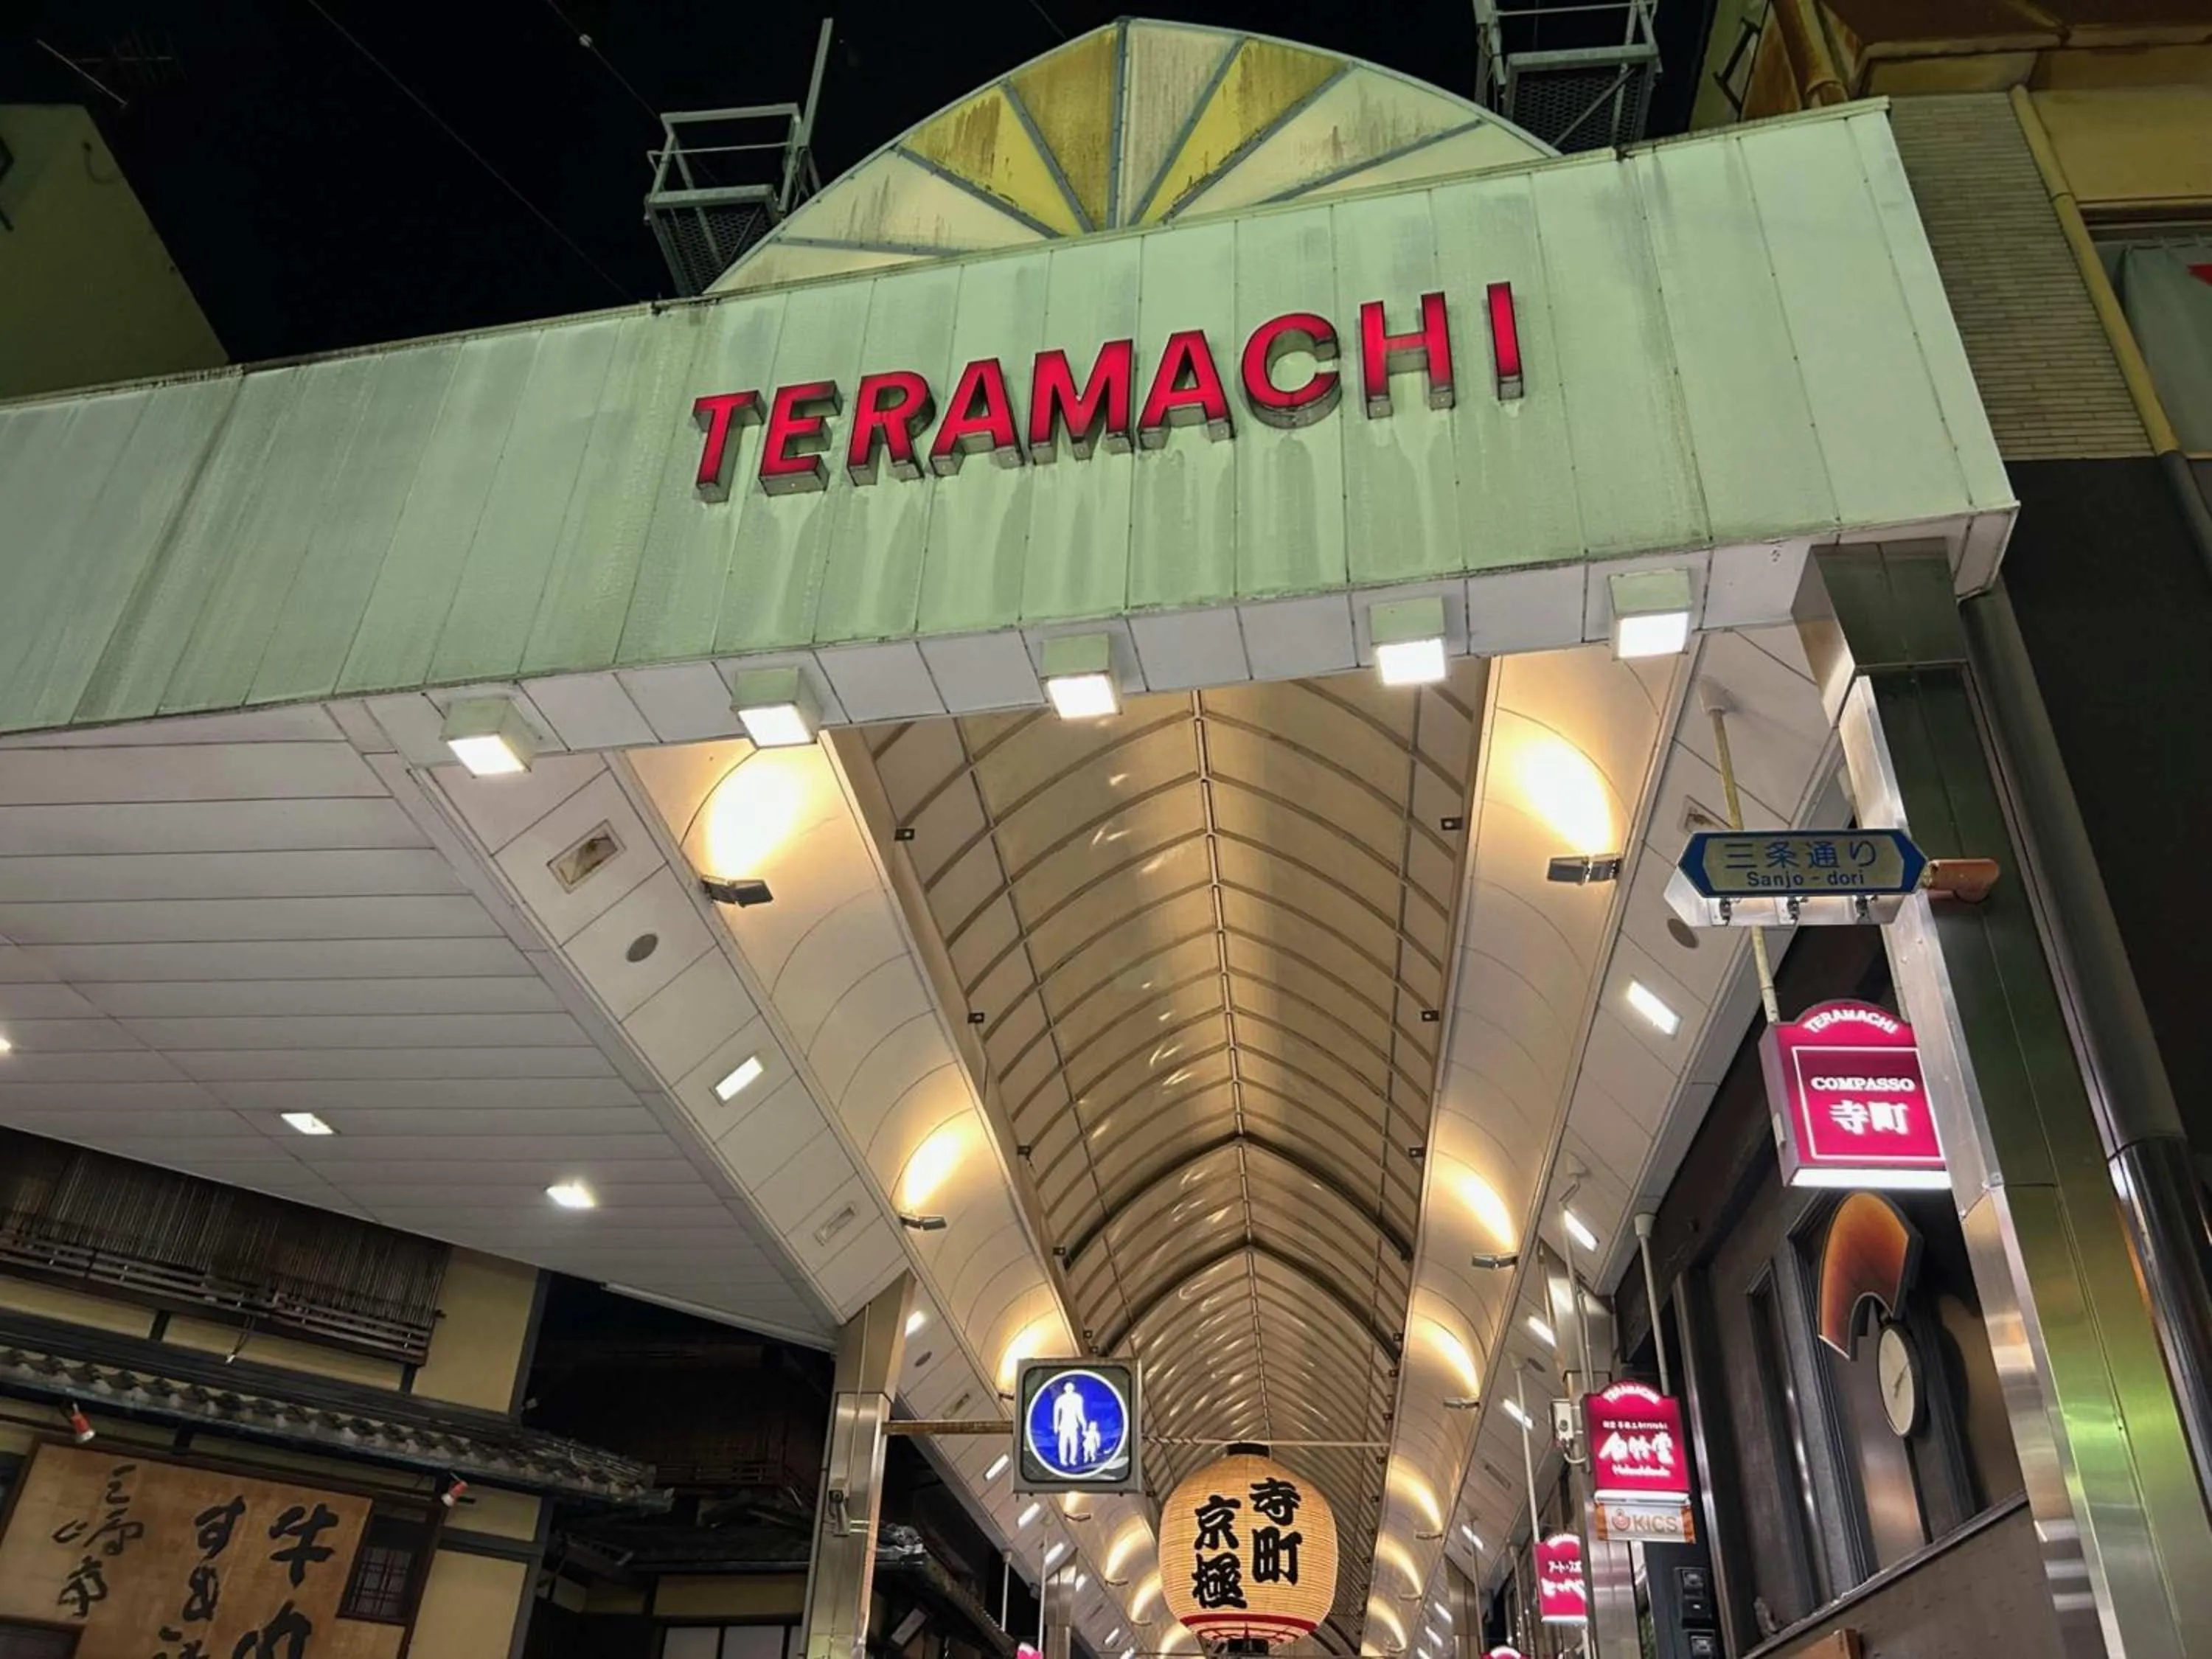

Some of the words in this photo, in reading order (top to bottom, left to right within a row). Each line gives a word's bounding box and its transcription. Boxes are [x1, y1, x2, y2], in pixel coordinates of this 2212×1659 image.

[692, 281, 1524, 498] TERAMACHI
[1725, 841, 1877, 869] 三条通り
[1803, 1009, 1899, 1034] TERAMACHI
[1811, 1077, 1916, 1092] COMPASSO
[1829, 1099, 1909, 1135] 寺町
[1249, 1478, 1303, 1585] 寺町
[1632, 1514, 1678, 1533] KICS
[1192, 1495, 1248, 1609] 京極
